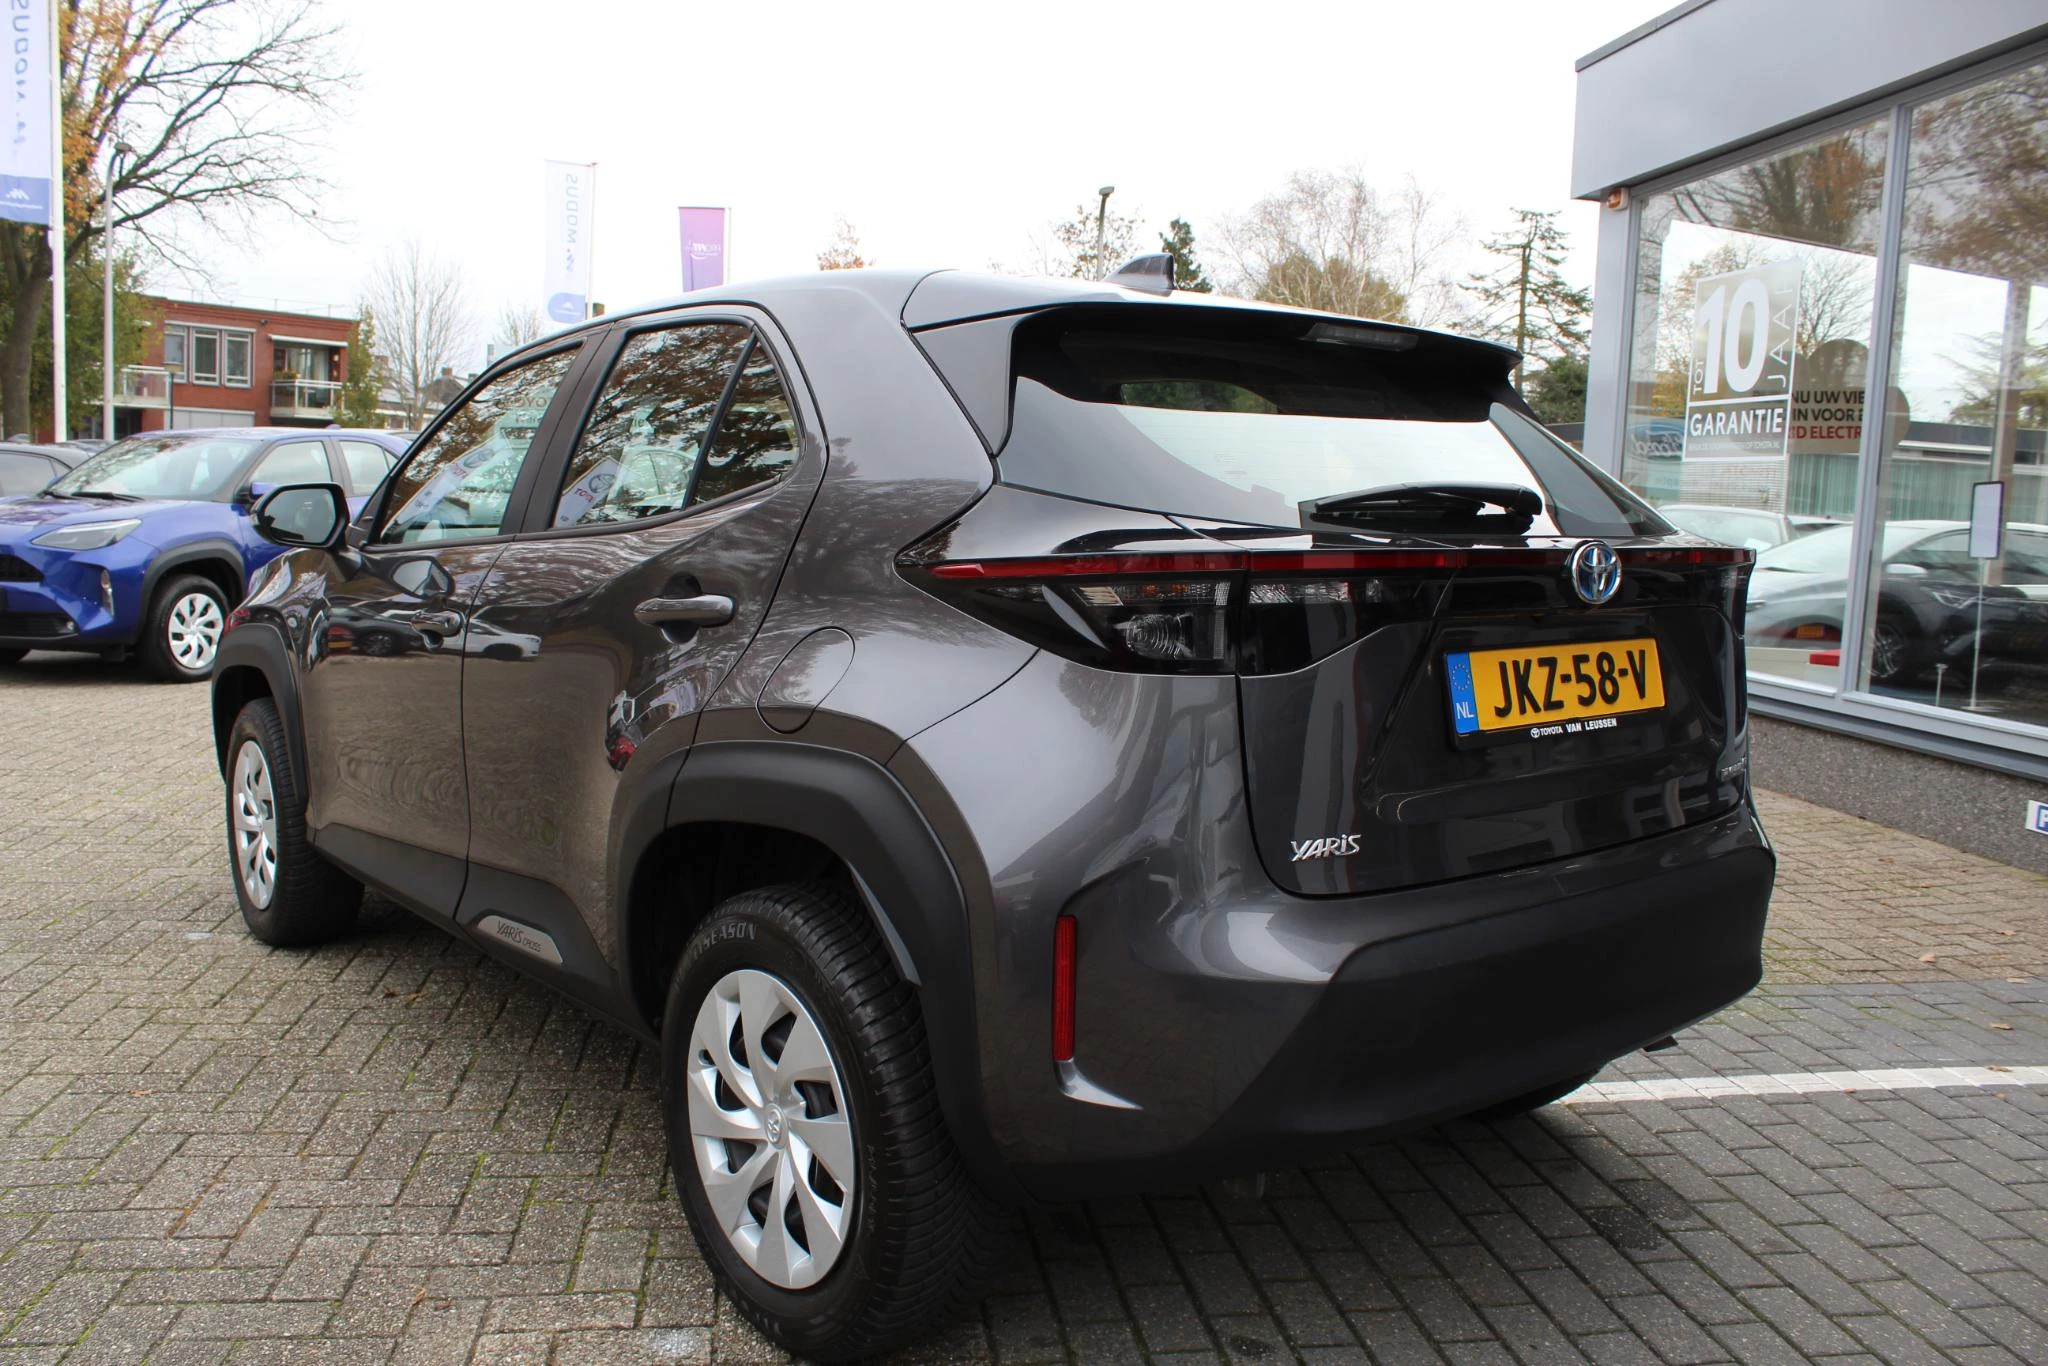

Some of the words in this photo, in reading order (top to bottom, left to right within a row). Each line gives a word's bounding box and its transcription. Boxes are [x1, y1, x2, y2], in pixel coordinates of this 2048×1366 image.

[1696, 278, 1770, 394] 10
[1692, 360, 1705, 395] TOT
[1814, 390, 1841, 404] UW
[1689, 407, 1784, 437] GARANTIE
[1811, 408, 1855, 421] VOOR
[1494, 649, 1646, 718] JKZ-58-V
[1456, 702, 1475, 720] NL
[1540, 726, 1564, 736] TOYOTA
[1566, 722, 1582, 733] VAN
[1584, 718, 1617, 731] LEUSSEN
